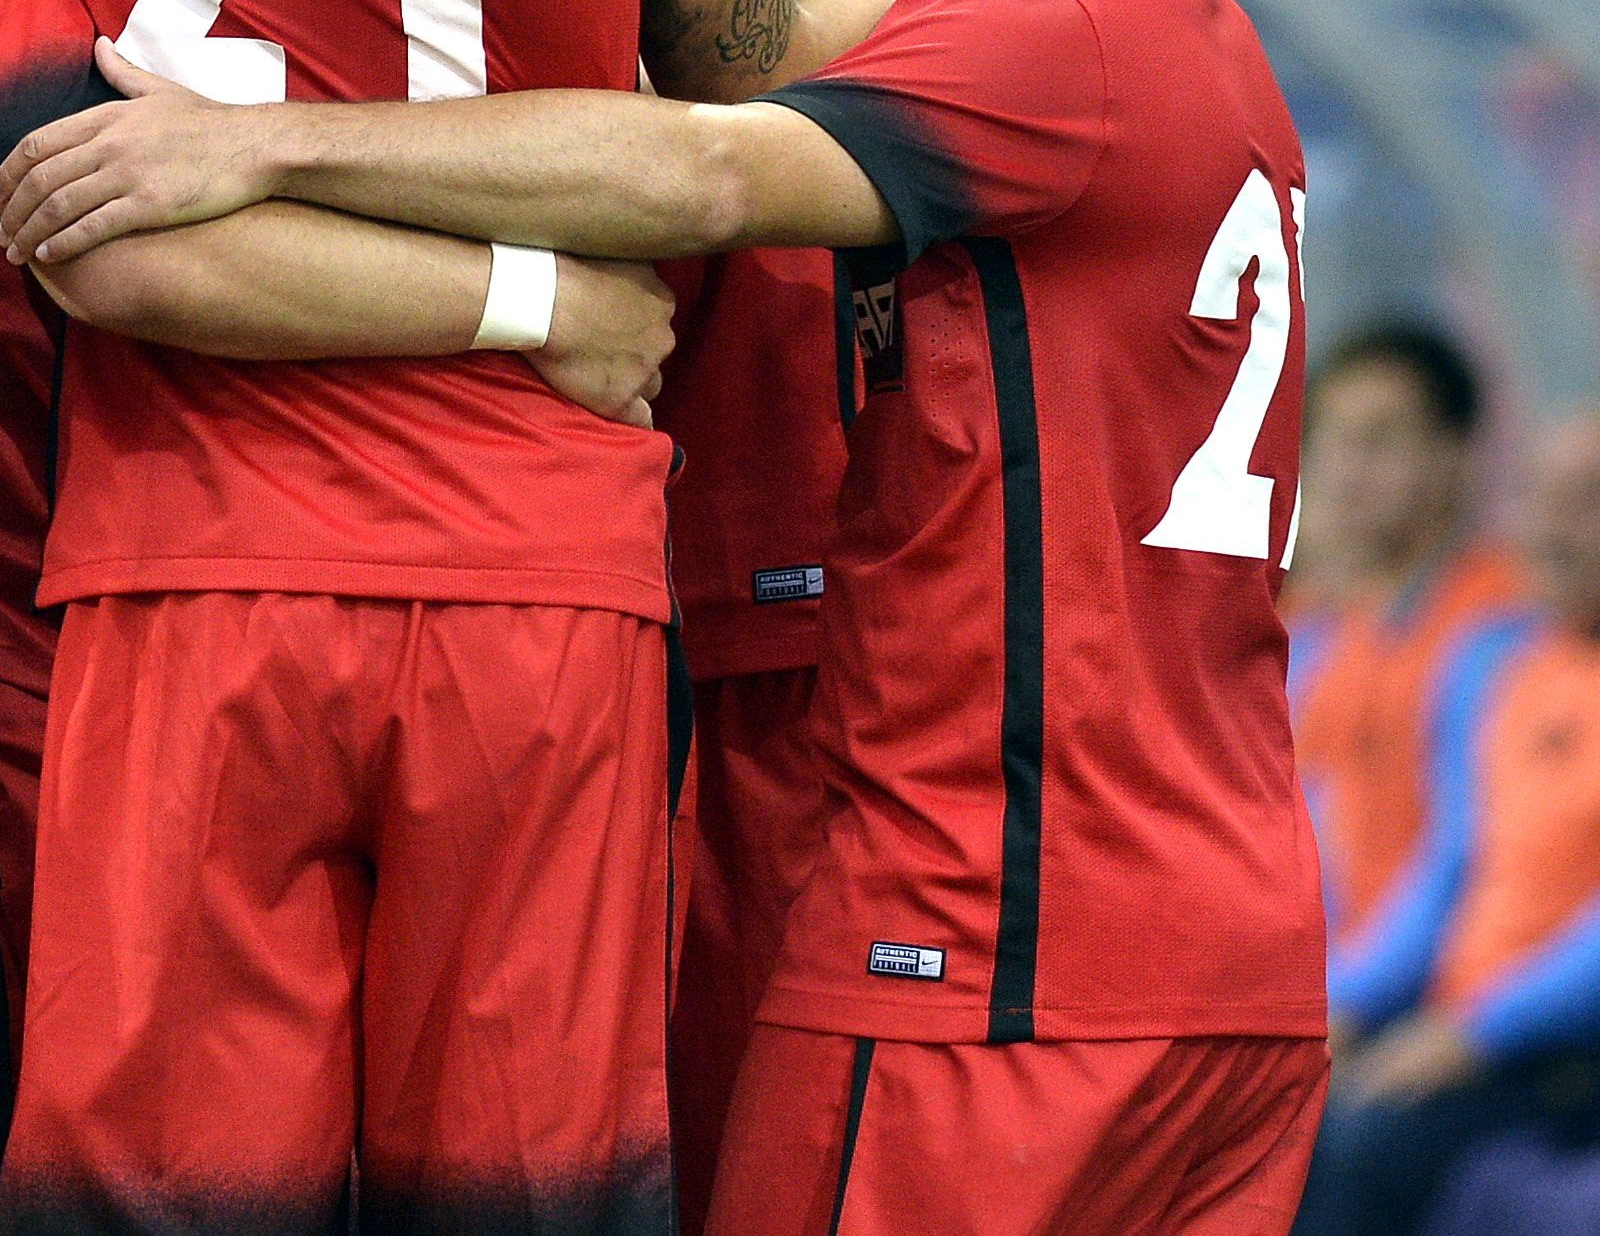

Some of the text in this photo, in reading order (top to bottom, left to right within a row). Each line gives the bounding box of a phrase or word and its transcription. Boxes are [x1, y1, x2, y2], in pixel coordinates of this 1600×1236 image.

[1140, 168, 1306, 572] 2
[760, 572, 804, 582] AUTHENTIC
[876, 947, 918, 959] AUTHENTIC
